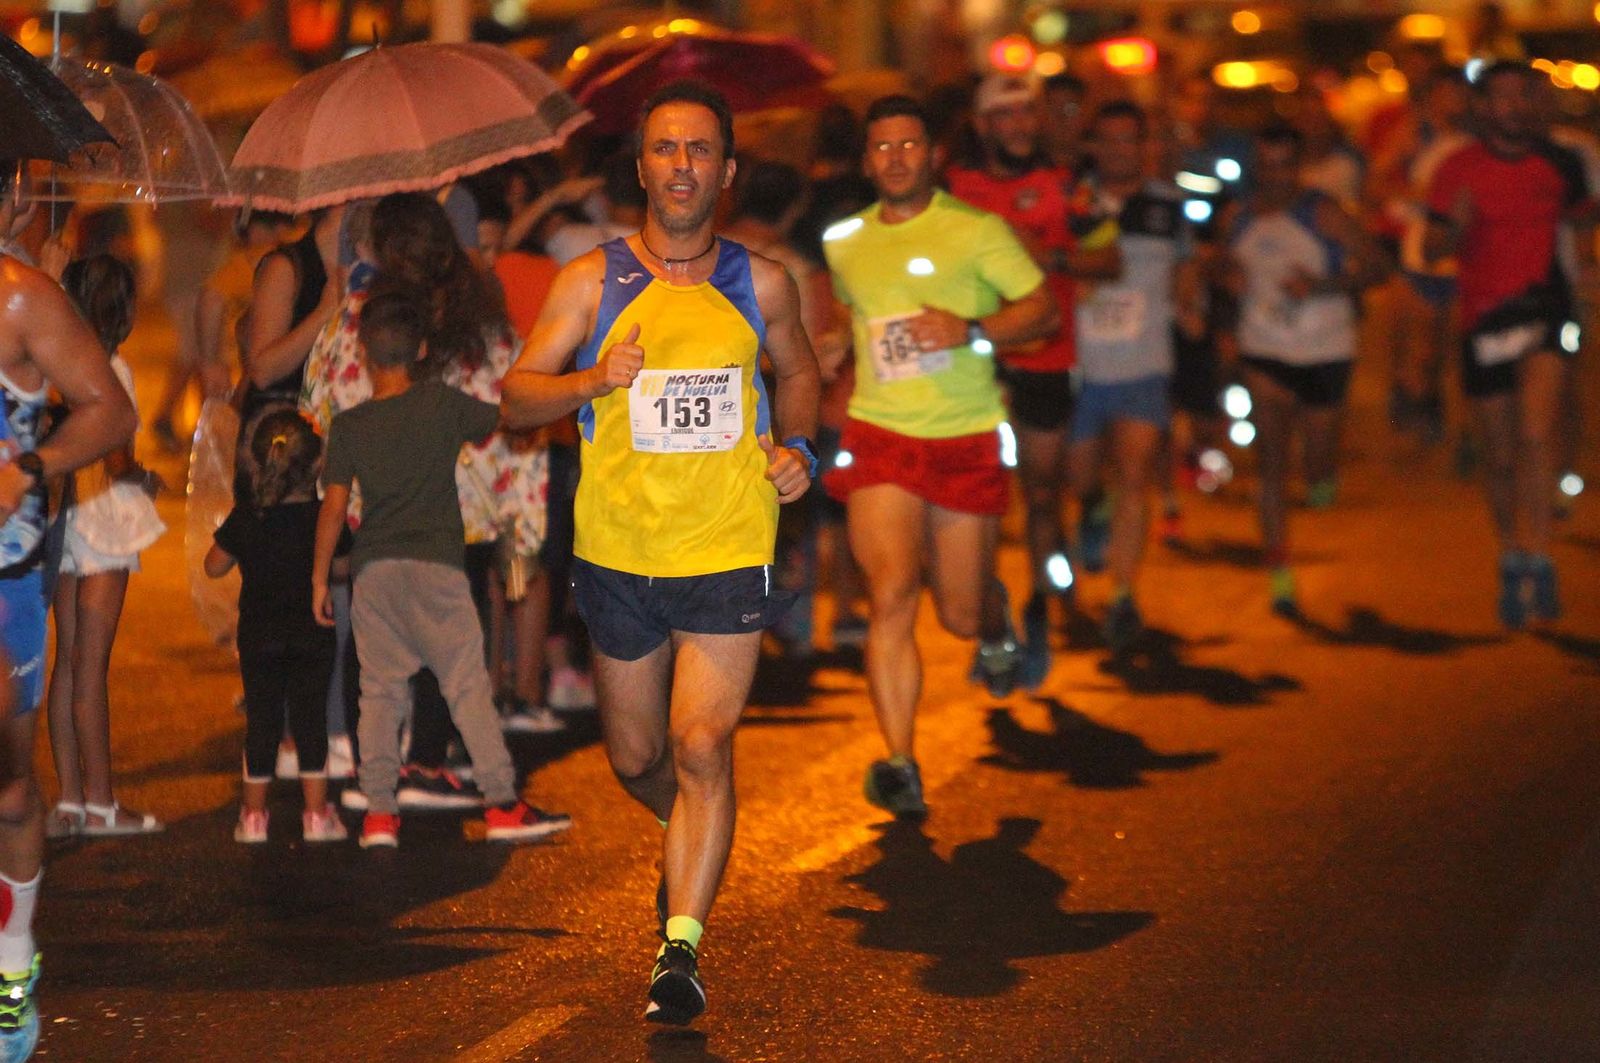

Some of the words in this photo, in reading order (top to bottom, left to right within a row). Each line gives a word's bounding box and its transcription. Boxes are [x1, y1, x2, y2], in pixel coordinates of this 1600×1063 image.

[666, 373, 729, 386] NOCTURNA
[663, 386, 680, 396] DE
[683, 385, 727, 397] HUELVA
[653, 397, 711, 427] 153
